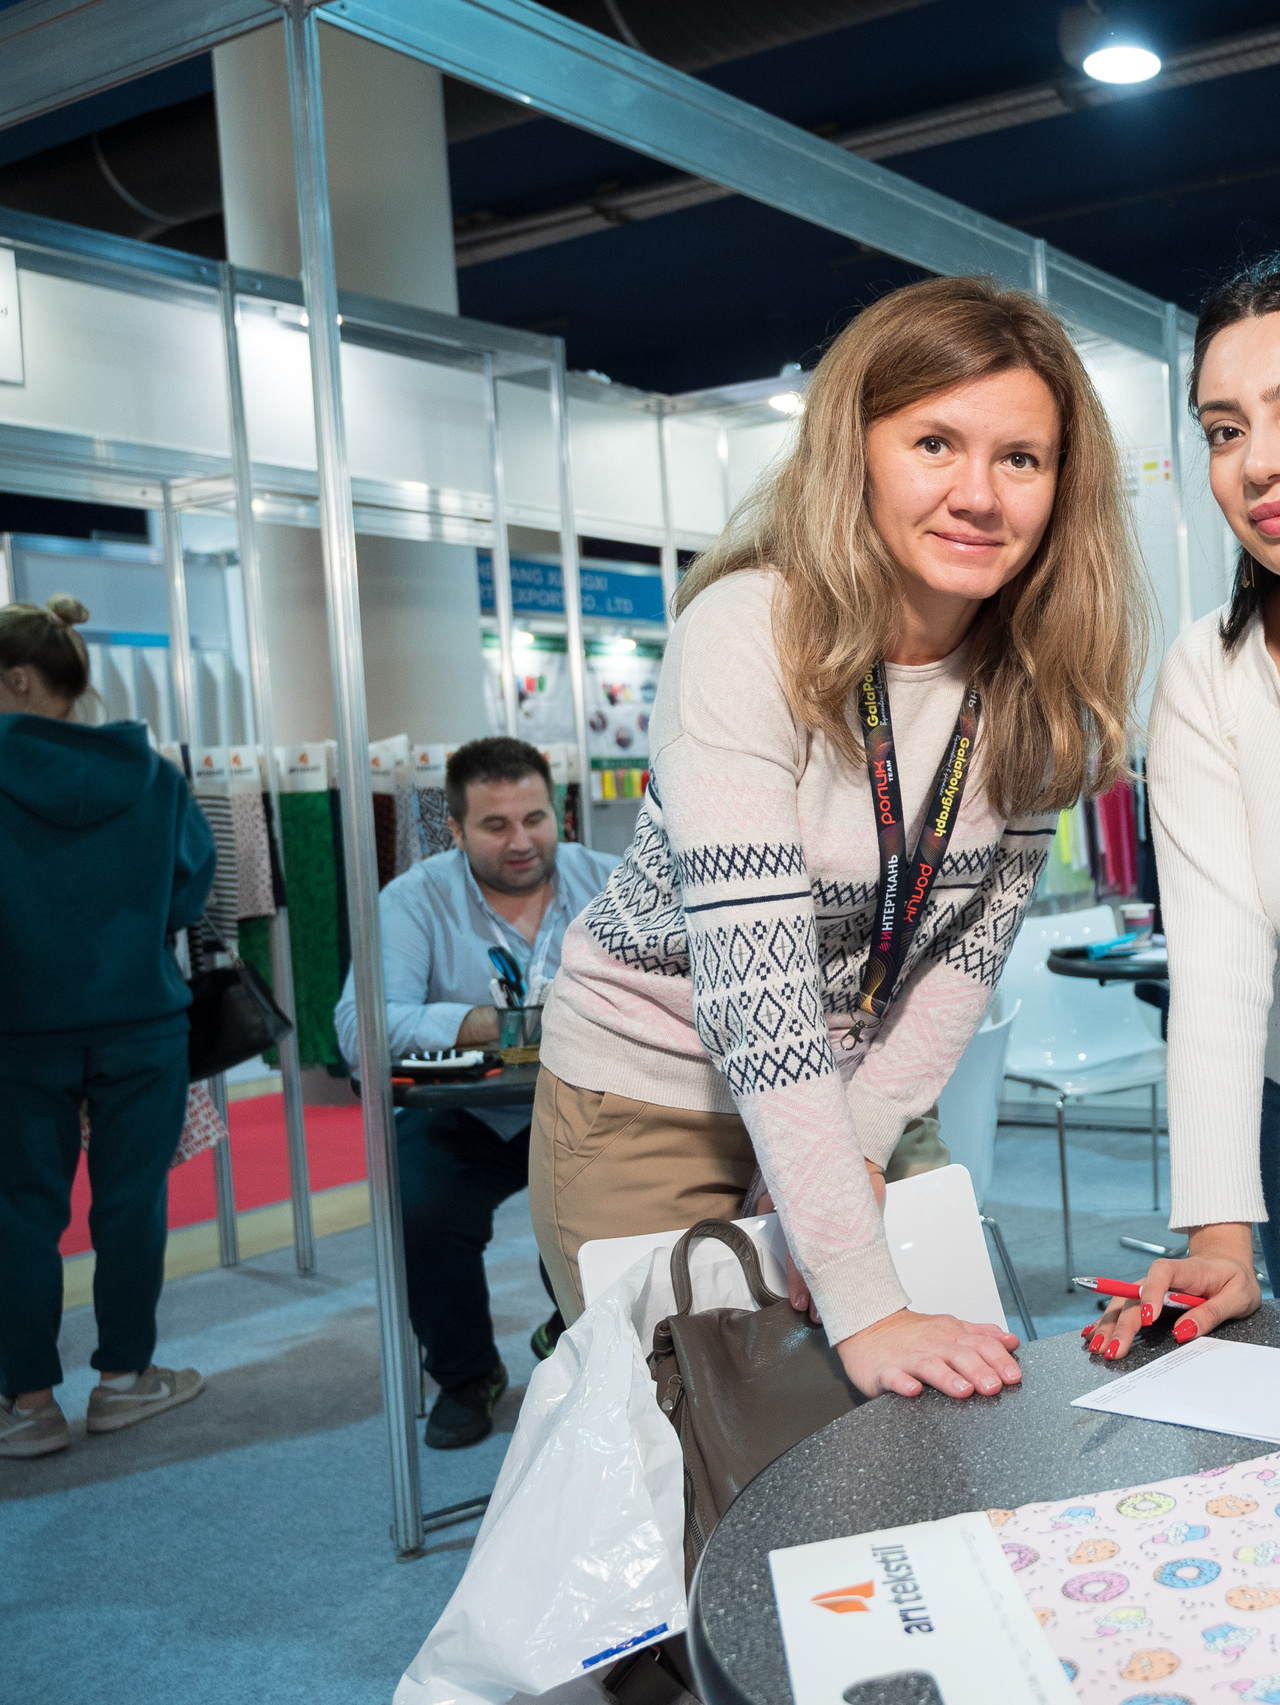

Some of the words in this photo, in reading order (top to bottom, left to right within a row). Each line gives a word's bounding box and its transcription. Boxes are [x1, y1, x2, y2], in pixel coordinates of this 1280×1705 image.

[874, 760, 896, 825] ролик
[886, 760, 894, 782] TEAM
[934, 736, 970, 838] GalaPolygraph
[880, 854, 899, 940] ИНТЕРТКАНЬ
[903, 863, 933, 923] ролик
[870, 1543, 922, 1605] tekstil
